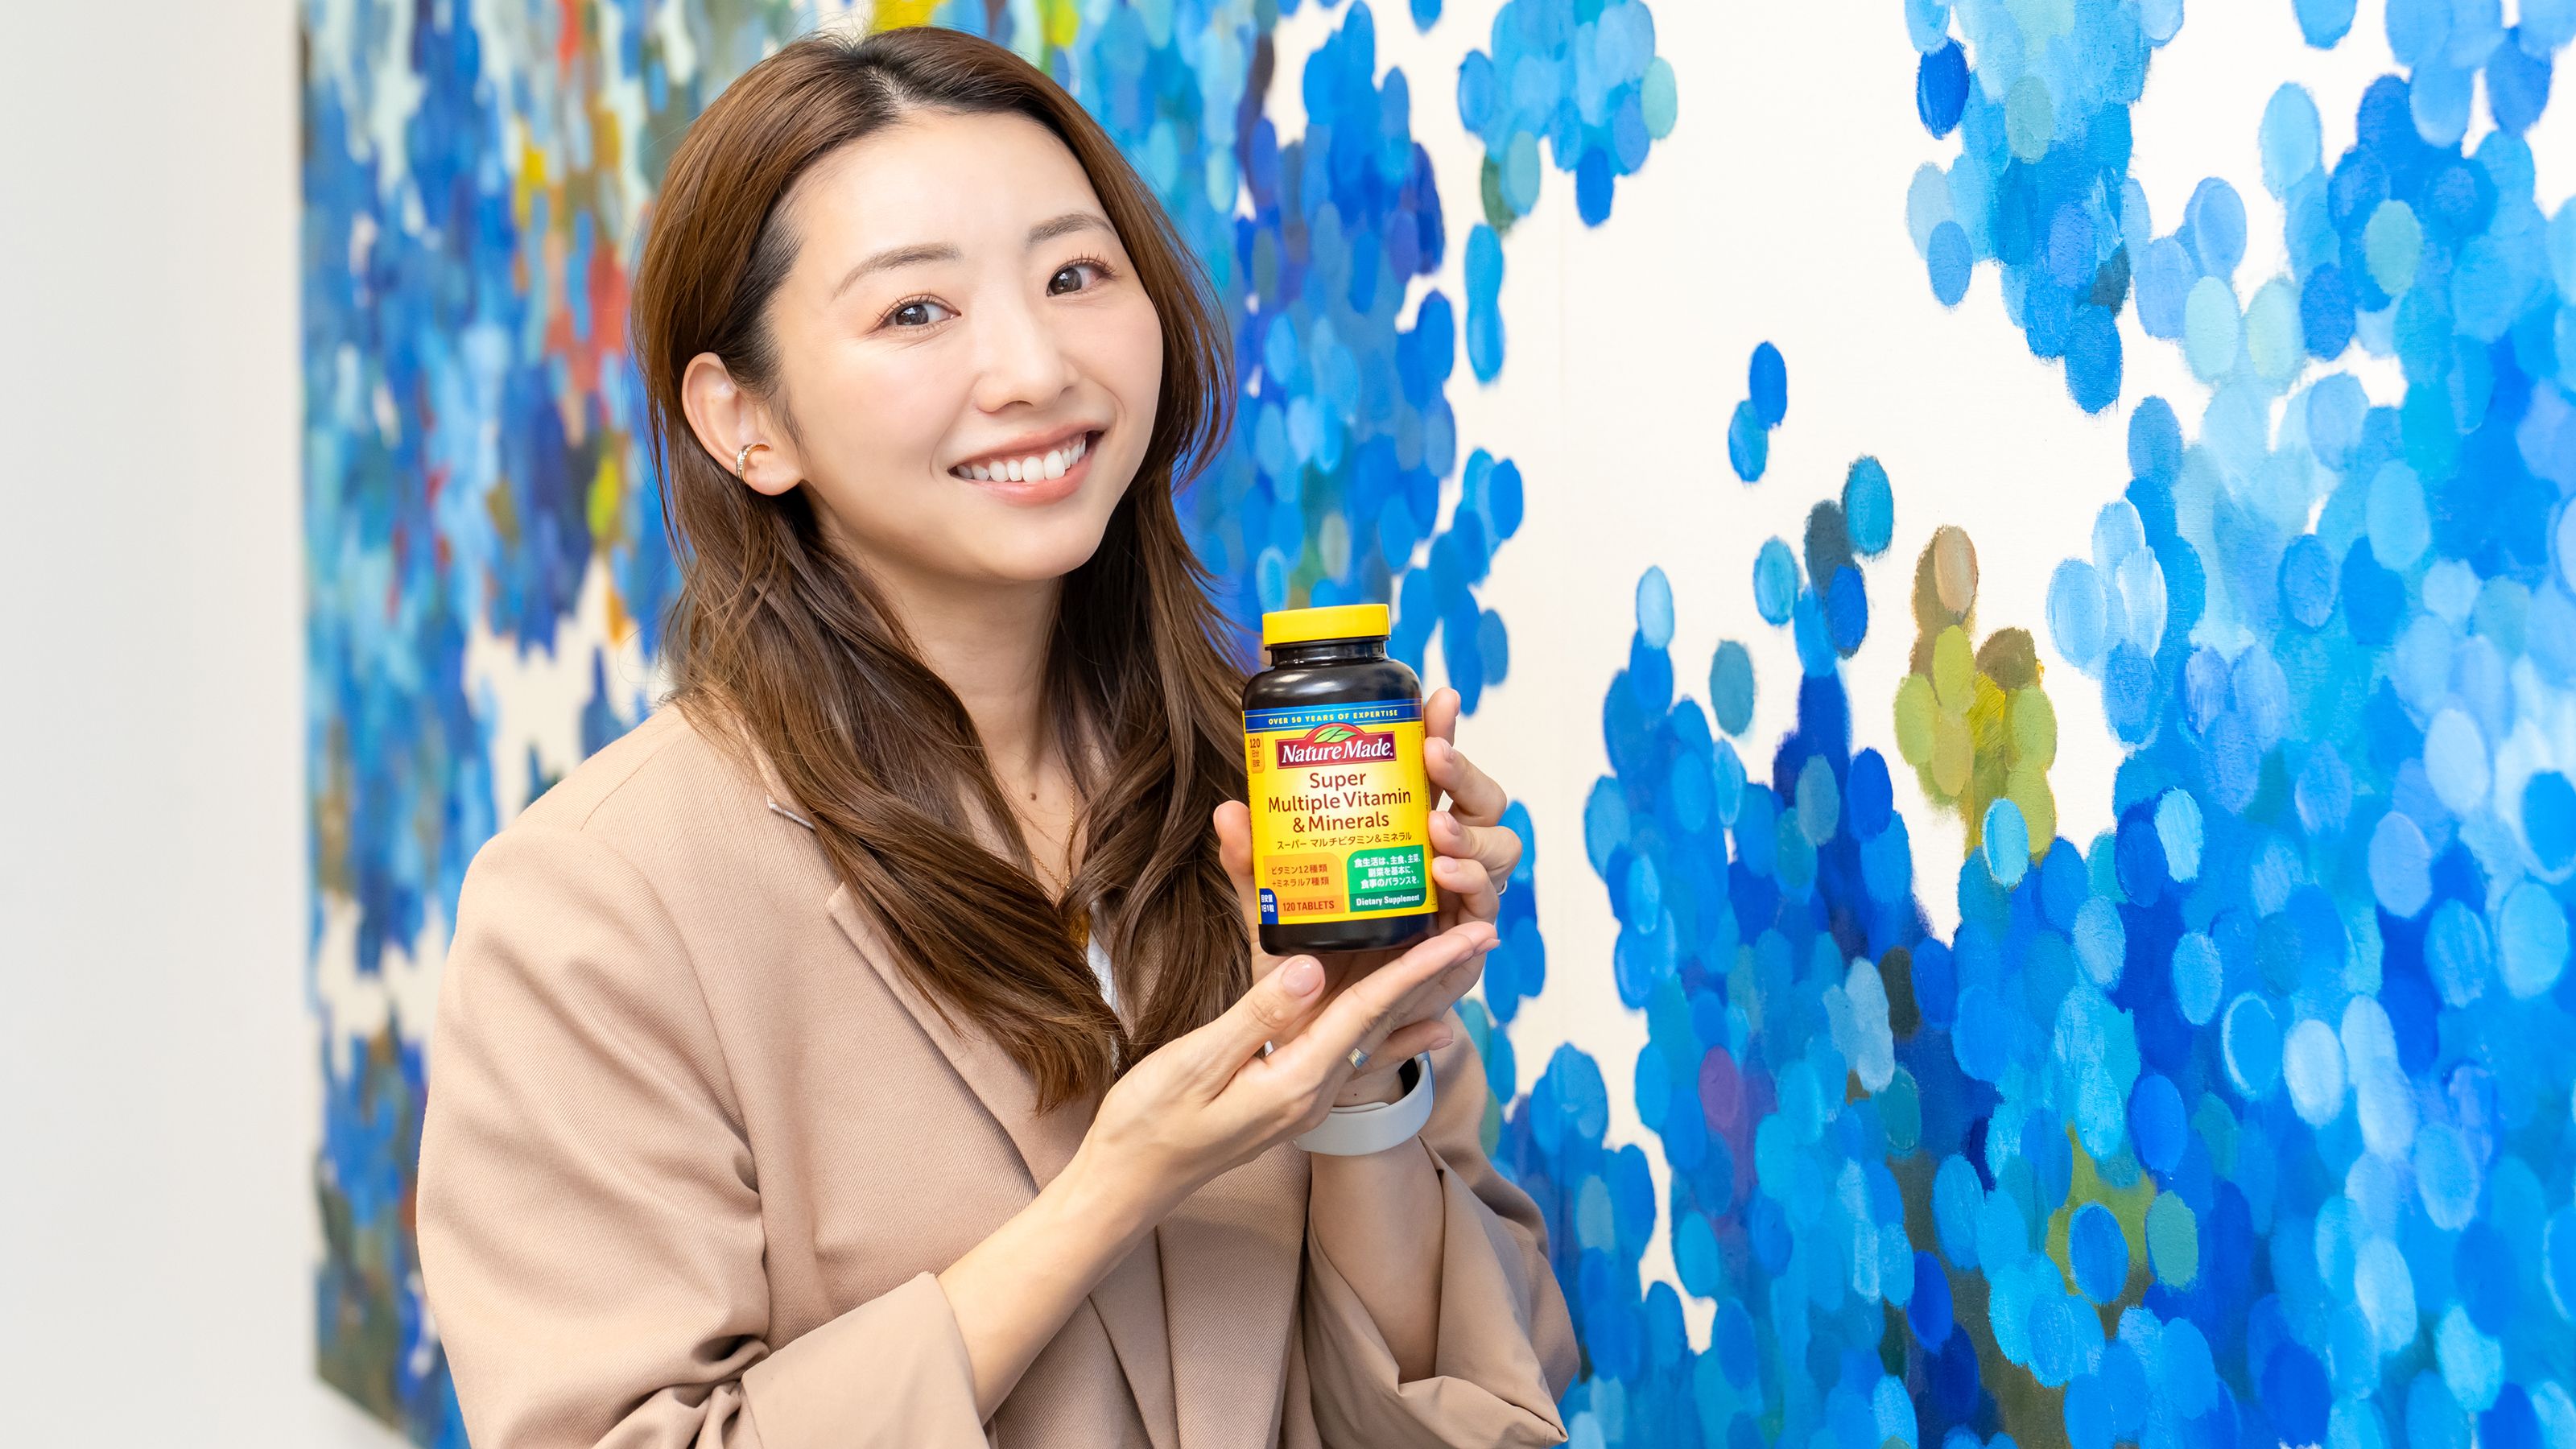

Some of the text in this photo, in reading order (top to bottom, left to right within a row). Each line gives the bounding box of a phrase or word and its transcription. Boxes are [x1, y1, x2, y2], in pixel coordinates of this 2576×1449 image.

[1268, 709, 1398, 725] OVER 50 YEARS OF EXPERTISE
[1250, 738, 1261, 749] 120
[1282, 745, 1342, 763] Nature
[1309, 772, 1367, 791] Super
[1268, 787, 1411, 815] Multiple Vitamin
[1293, 811, 1389, 833] & Minerals
[1277, 840, 1307, 850] スーパー
[1271, 864, 1327, 875] ビタミン12種類
[1282, 900, 1335, 912] 120 TABLETS
[1356, 894, 1420, 906] Dietary Supplement
